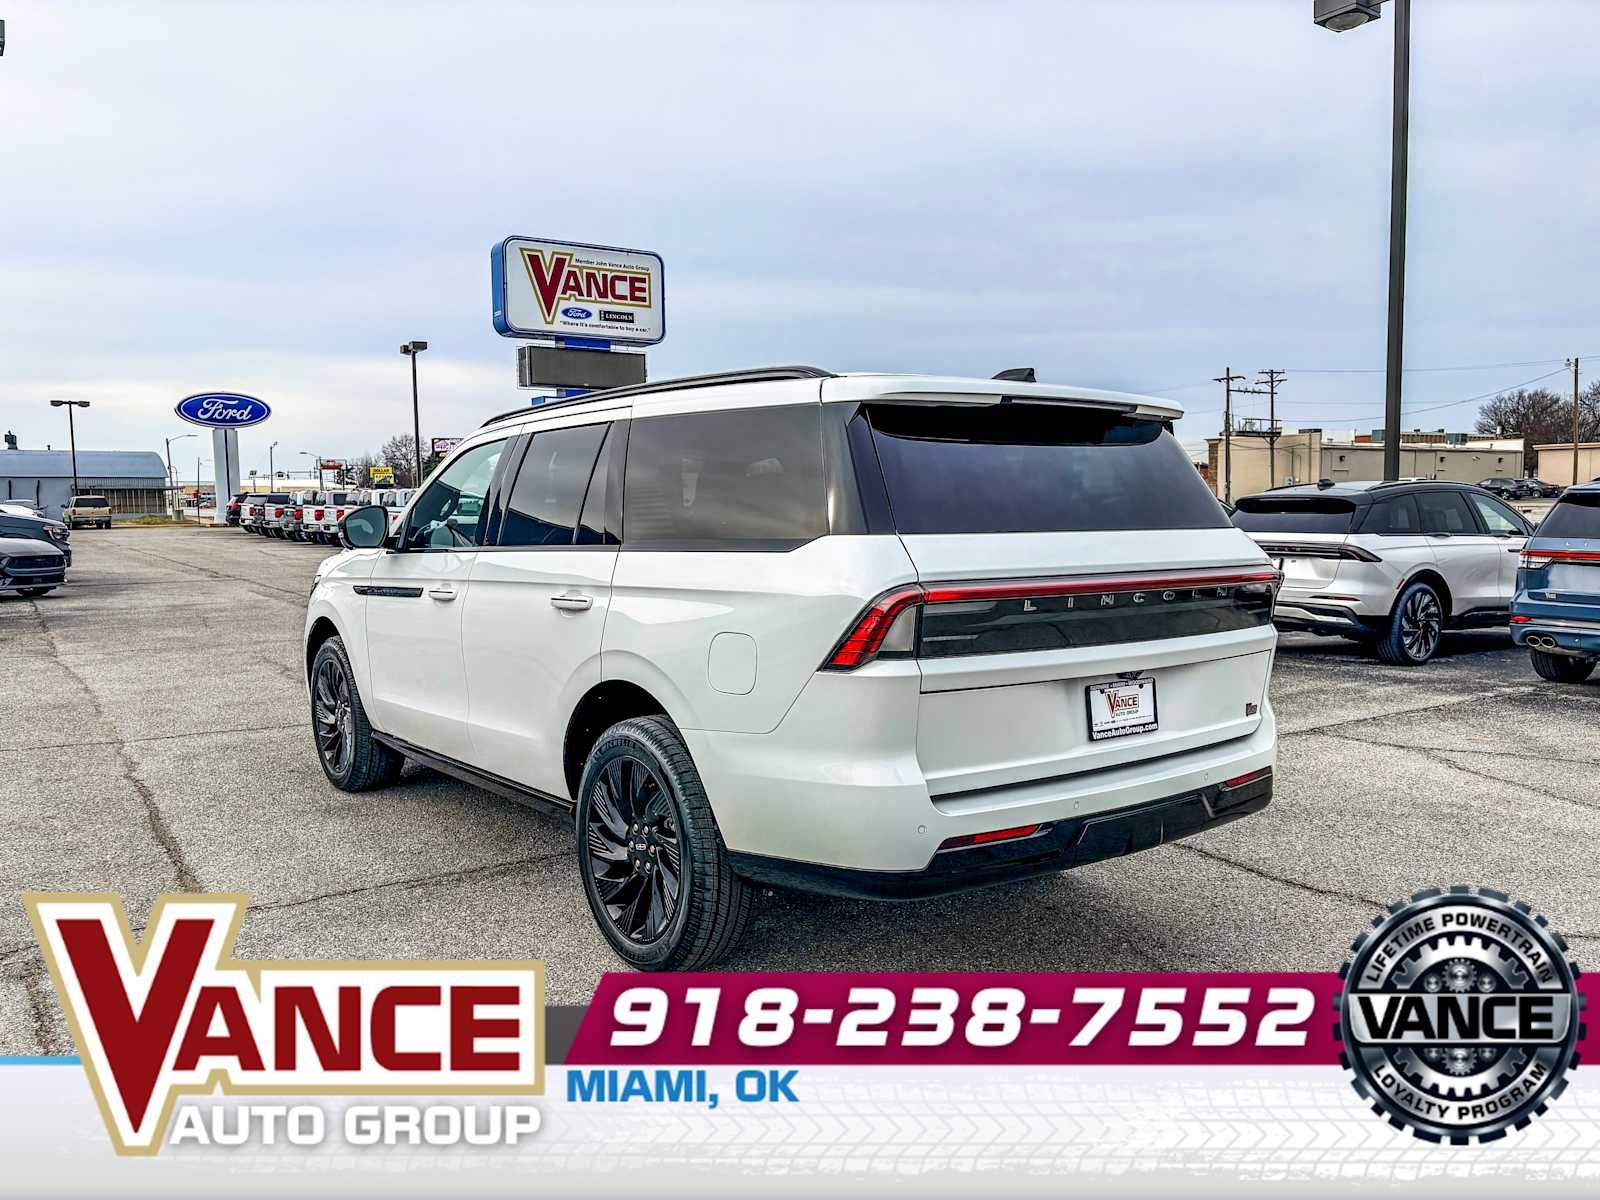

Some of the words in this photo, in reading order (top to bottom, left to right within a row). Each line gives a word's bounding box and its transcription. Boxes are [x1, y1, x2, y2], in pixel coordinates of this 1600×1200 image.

[635, 264, 650, 272] Group
[527, 253, 648, 319] VANCE
[605, 312, 633, 321] LINCOLN
[197, 398, 252, 421] Ford
[1023, 586, 1228, 612] LINCOLN
[1107, 692, 1138, 714] VANCE
[1092, 723, 1158, 740] VanceAutoGroup.com
